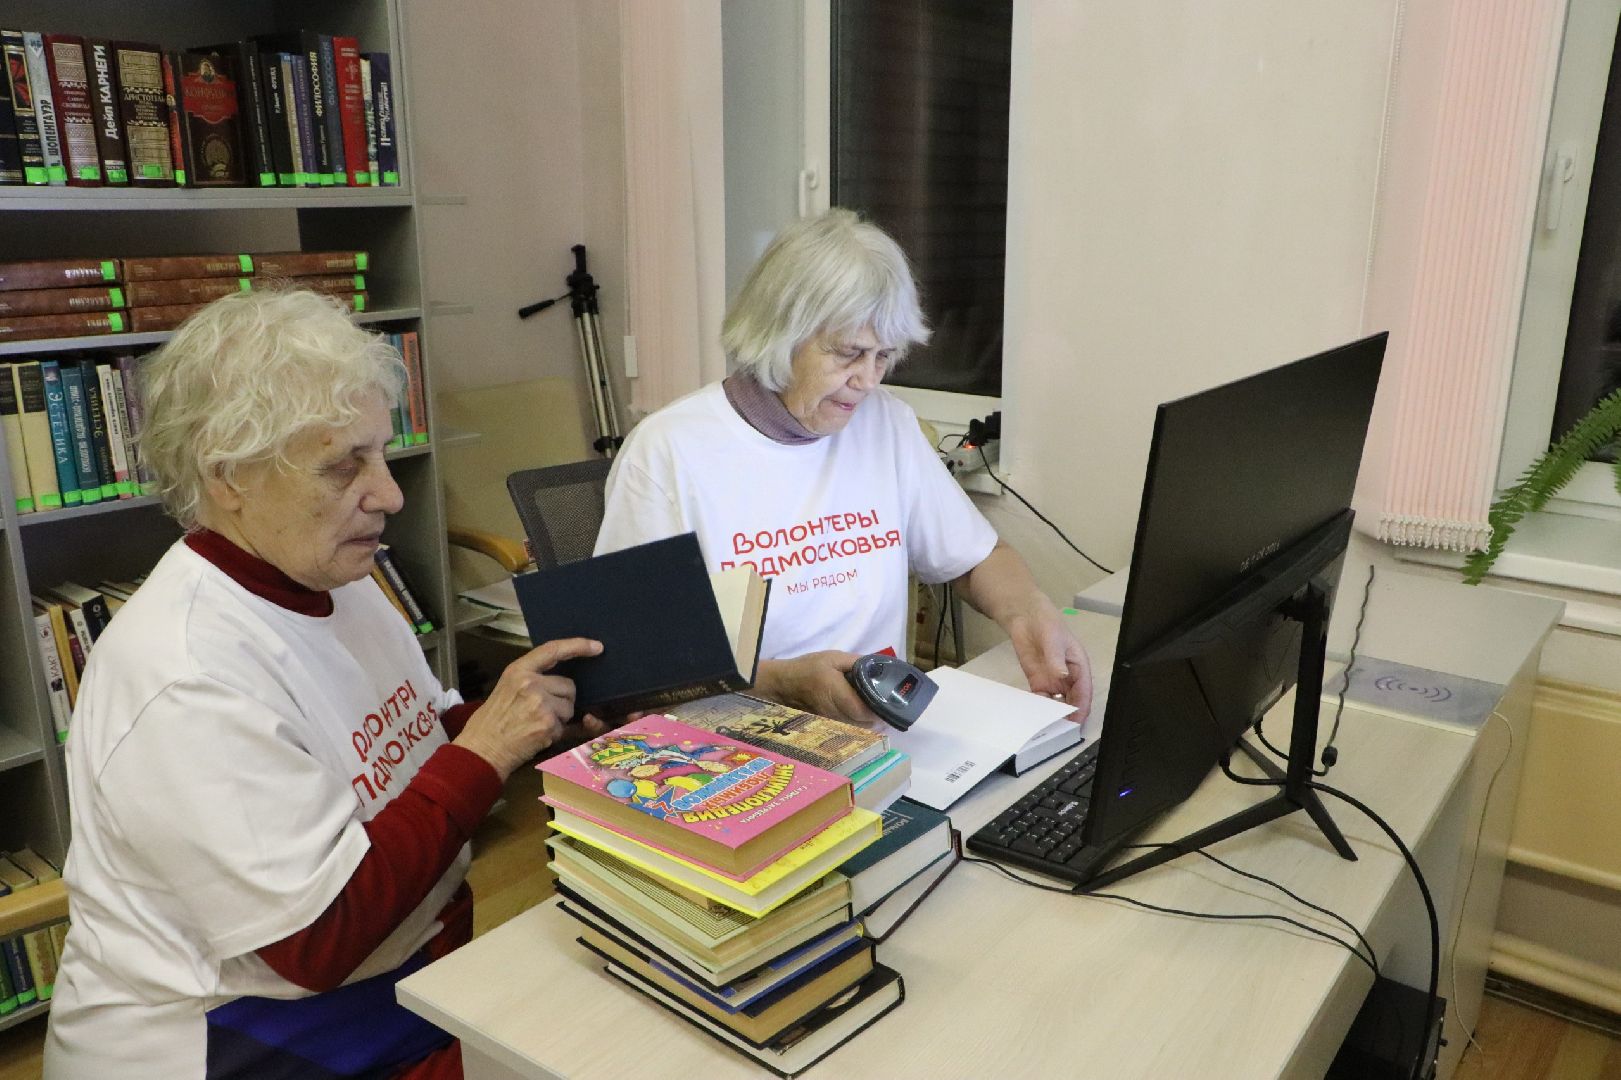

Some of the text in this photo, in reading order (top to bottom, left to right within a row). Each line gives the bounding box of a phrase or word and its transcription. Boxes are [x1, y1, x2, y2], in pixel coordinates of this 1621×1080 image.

[93, 45, 119, 139] Дейл КАРНЕГИ
[309, 51, 322, 117] ФИЛОСОФИЯ
[41, 99, 59, 156] ШОПЕНГАУЭР
[48, 392, 69, 464] ЭСТЕТИКА
[88, 386, 104, 439] ЭСТЕТИКА
[733, 509, 880, 555] ВОЛОНТЕРЫ
[787, 569, 858, 595] МЫ РЯДОМ
[682, 763, 795, 823] ЭНЦИКЛОПЕДИЯ
[702, 771, 771, 810] ЛЮБИМЫХ
